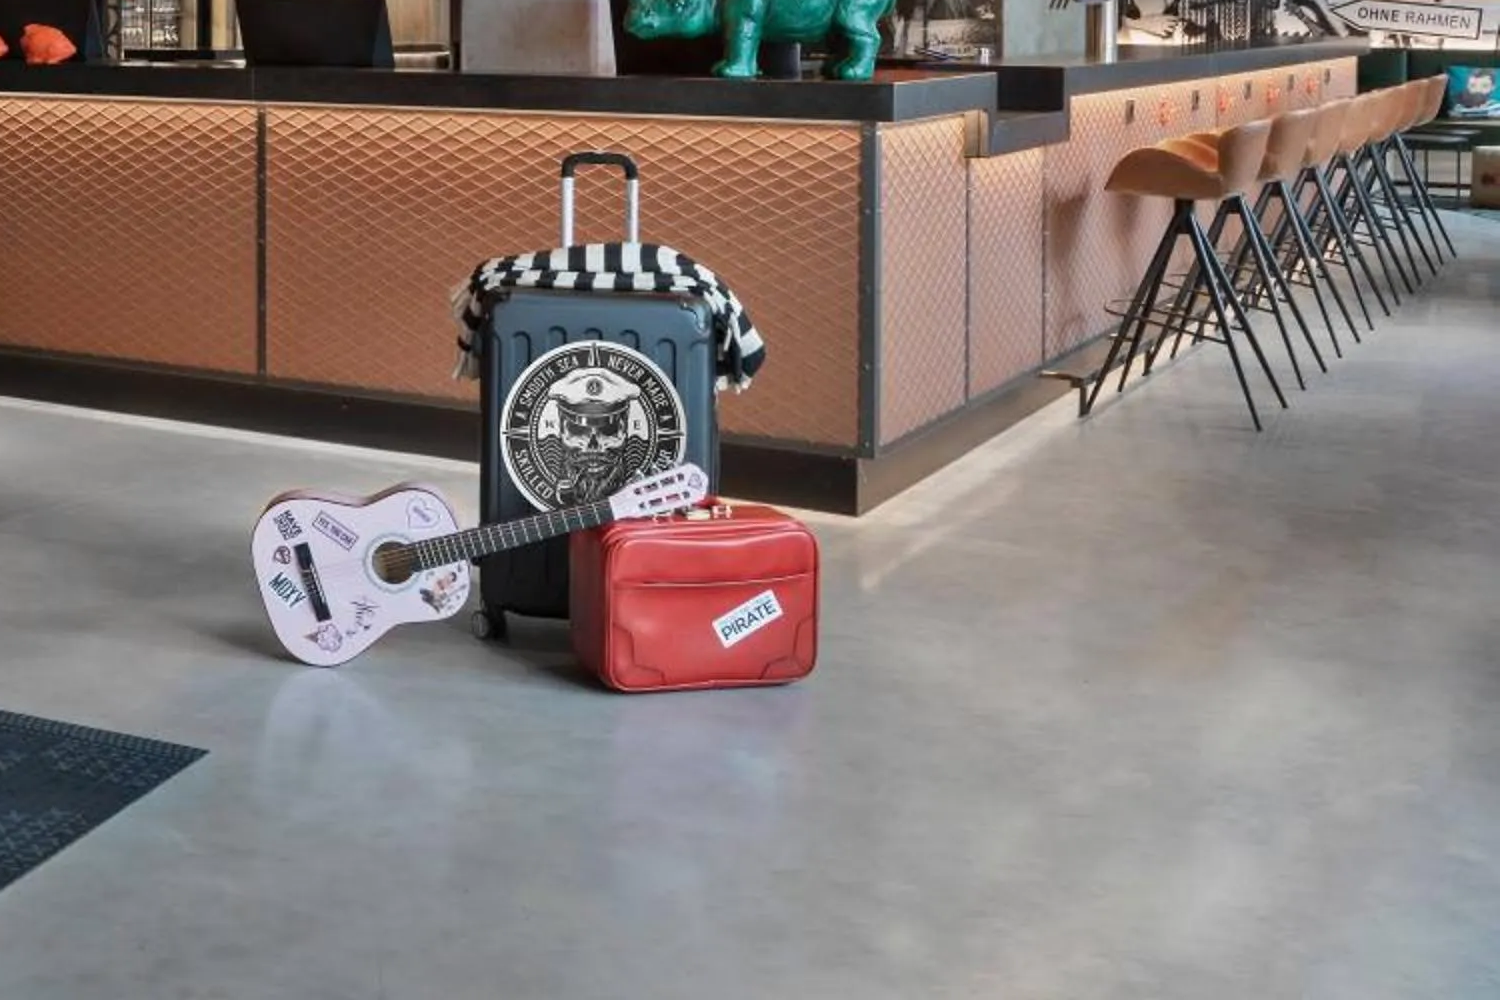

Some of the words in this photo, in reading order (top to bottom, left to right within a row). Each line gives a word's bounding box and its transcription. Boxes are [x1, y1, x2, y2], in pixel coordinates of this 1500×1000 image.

[1357, 6, 1400, 22] OHNE
[1405, 12, 1471, 29] RAHMEN
[519, 366, 557, 407] SMOOTH
[557, 355, 579, 373] SEA
[607, 355, 642, 384] NEVER
[641, 376, 669, 409] MADE
[515, 450, 554, 499] SKILLED
[268, 571, 307, 608] MOXY
[721, 599, 777, 640] PIRATE
